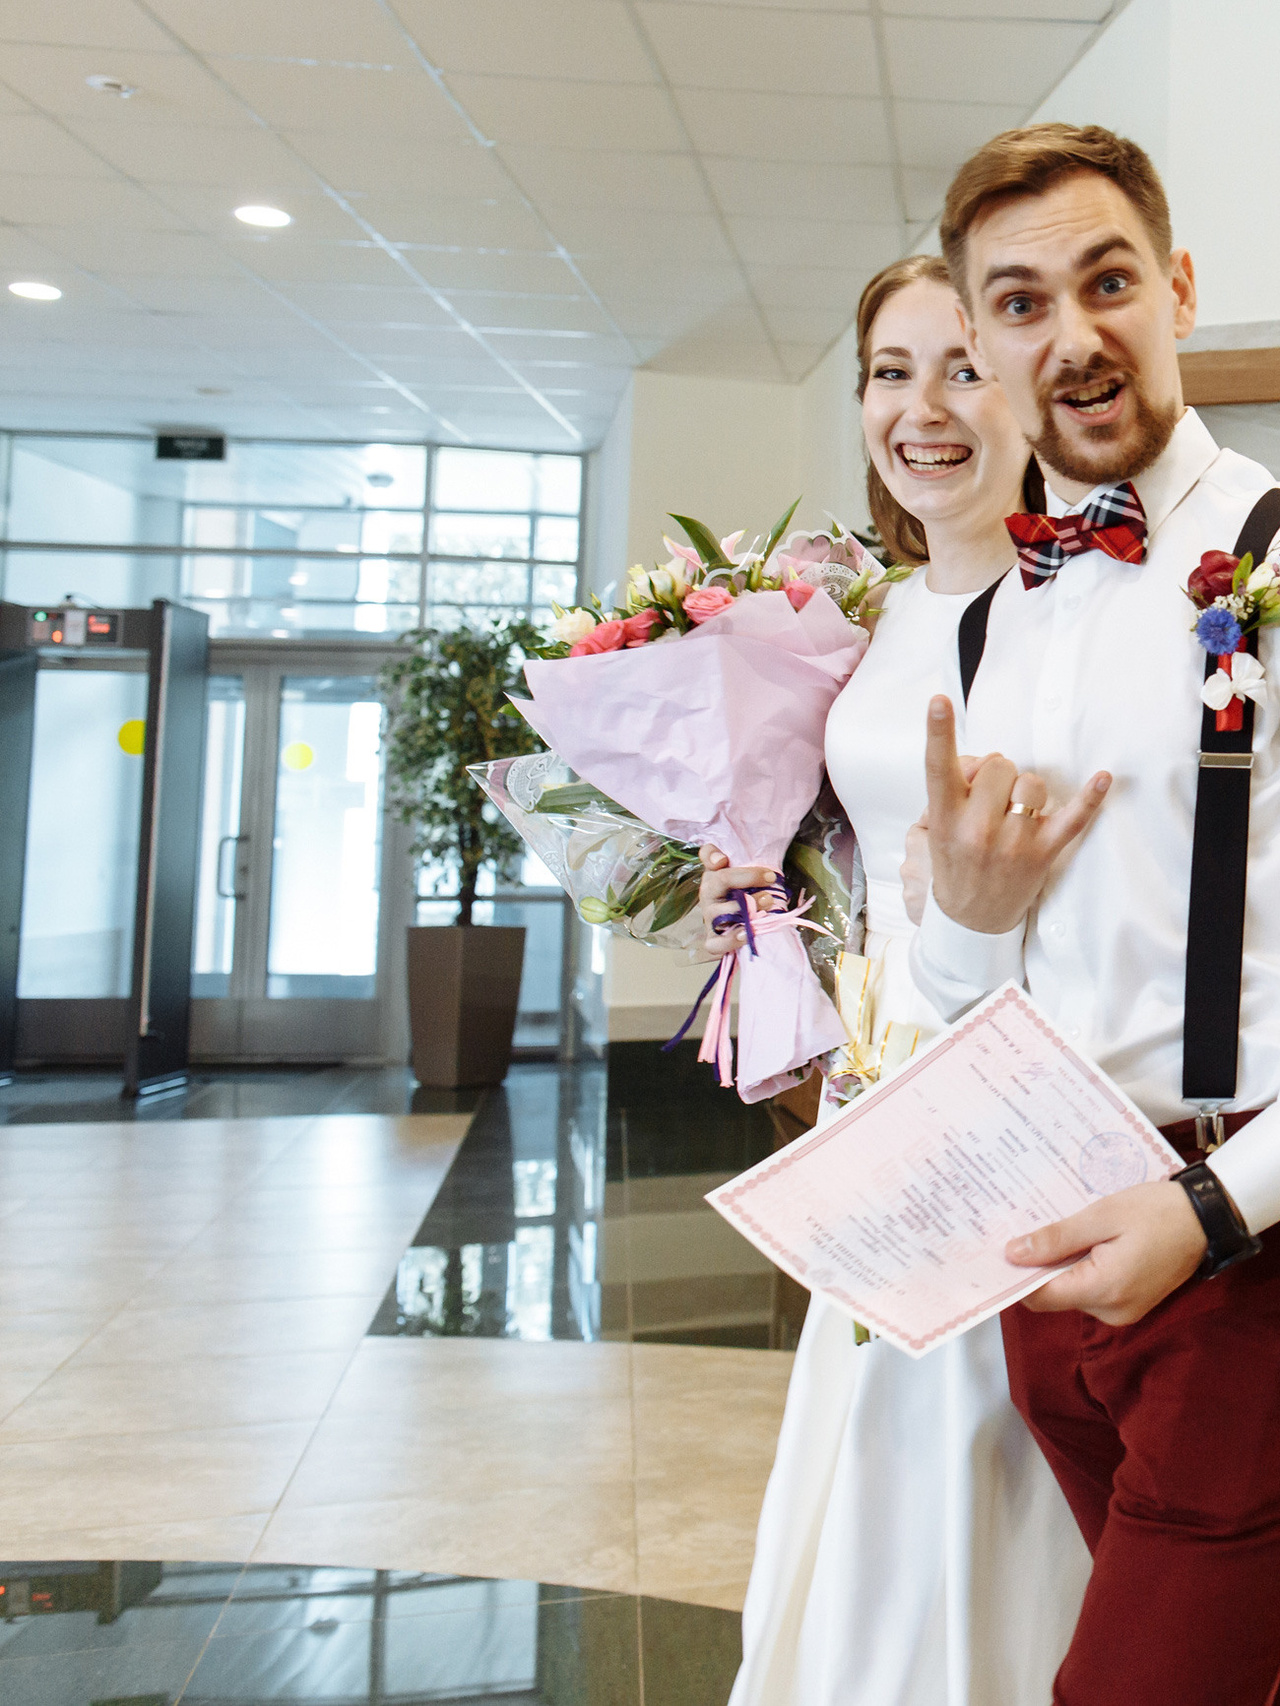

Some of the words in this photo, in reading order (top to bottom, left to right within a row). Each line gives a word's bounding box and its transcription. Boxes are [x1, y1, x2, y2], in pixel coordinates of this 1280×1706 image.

[803, 1214, 835, 1242] БРАКА
[806, 1233, 883, 1291] СВИДЕТЕЛЬСТВО
[833, 1241, 895, 1289] ЗАКЛЮЧЕНИИ
[895, 1287, 906, 1296] О
